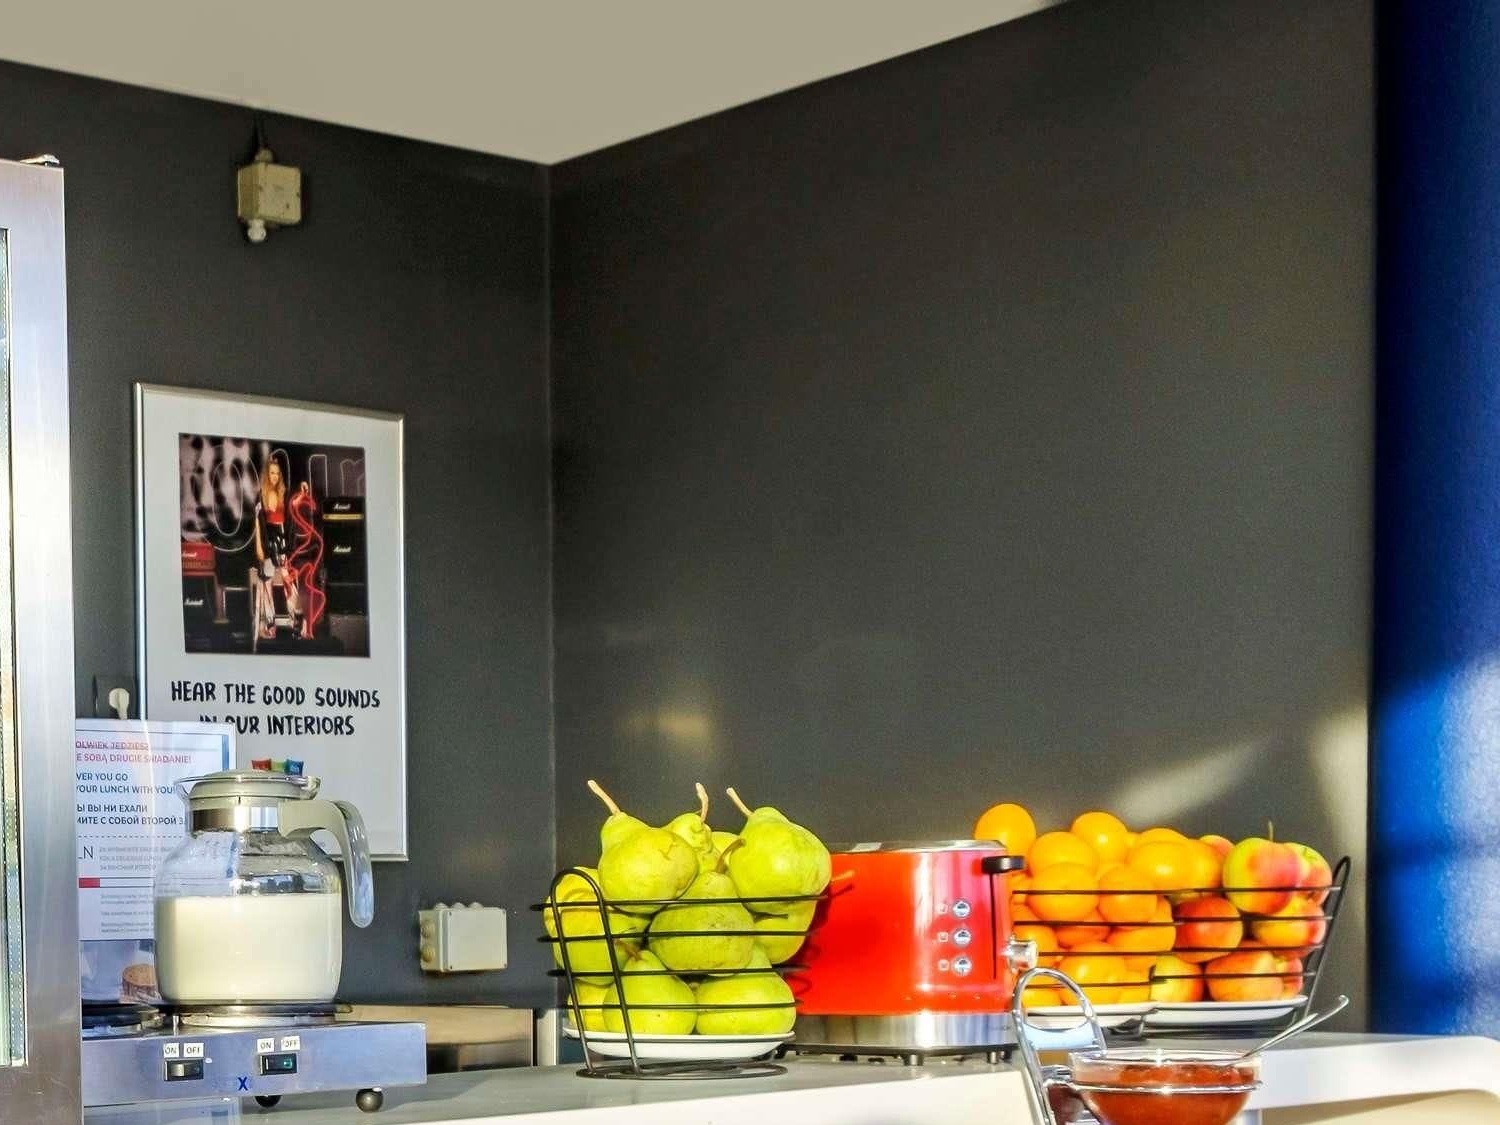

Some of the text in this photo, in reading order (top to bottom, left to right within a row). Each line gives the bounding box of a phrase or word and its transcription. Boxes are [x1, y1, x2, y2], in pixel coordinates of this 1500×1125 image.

[171, 681, 381, 708] HEAR THE GOOD SOUNDS
[267, 715, 355, 736] INTERIORS
[95, 773, 113, 781] YOU
[115, 773, 128, 781] GO
[100, 785, 130, 794] LUNCH
[132, 786, 153, 794] WITH
[88, 804, 101, 812] ВЫ
[104, 804, 117, 812] НИ
[120, 804, 147, 813] ЕХАЛИ
[100, 817, 106, 825] С
[108, 815, 139, 825] СОБОЙ
[141, 815, 177, 825] ВТОРОЙ
[260, 1041, 272, 1049] ON
